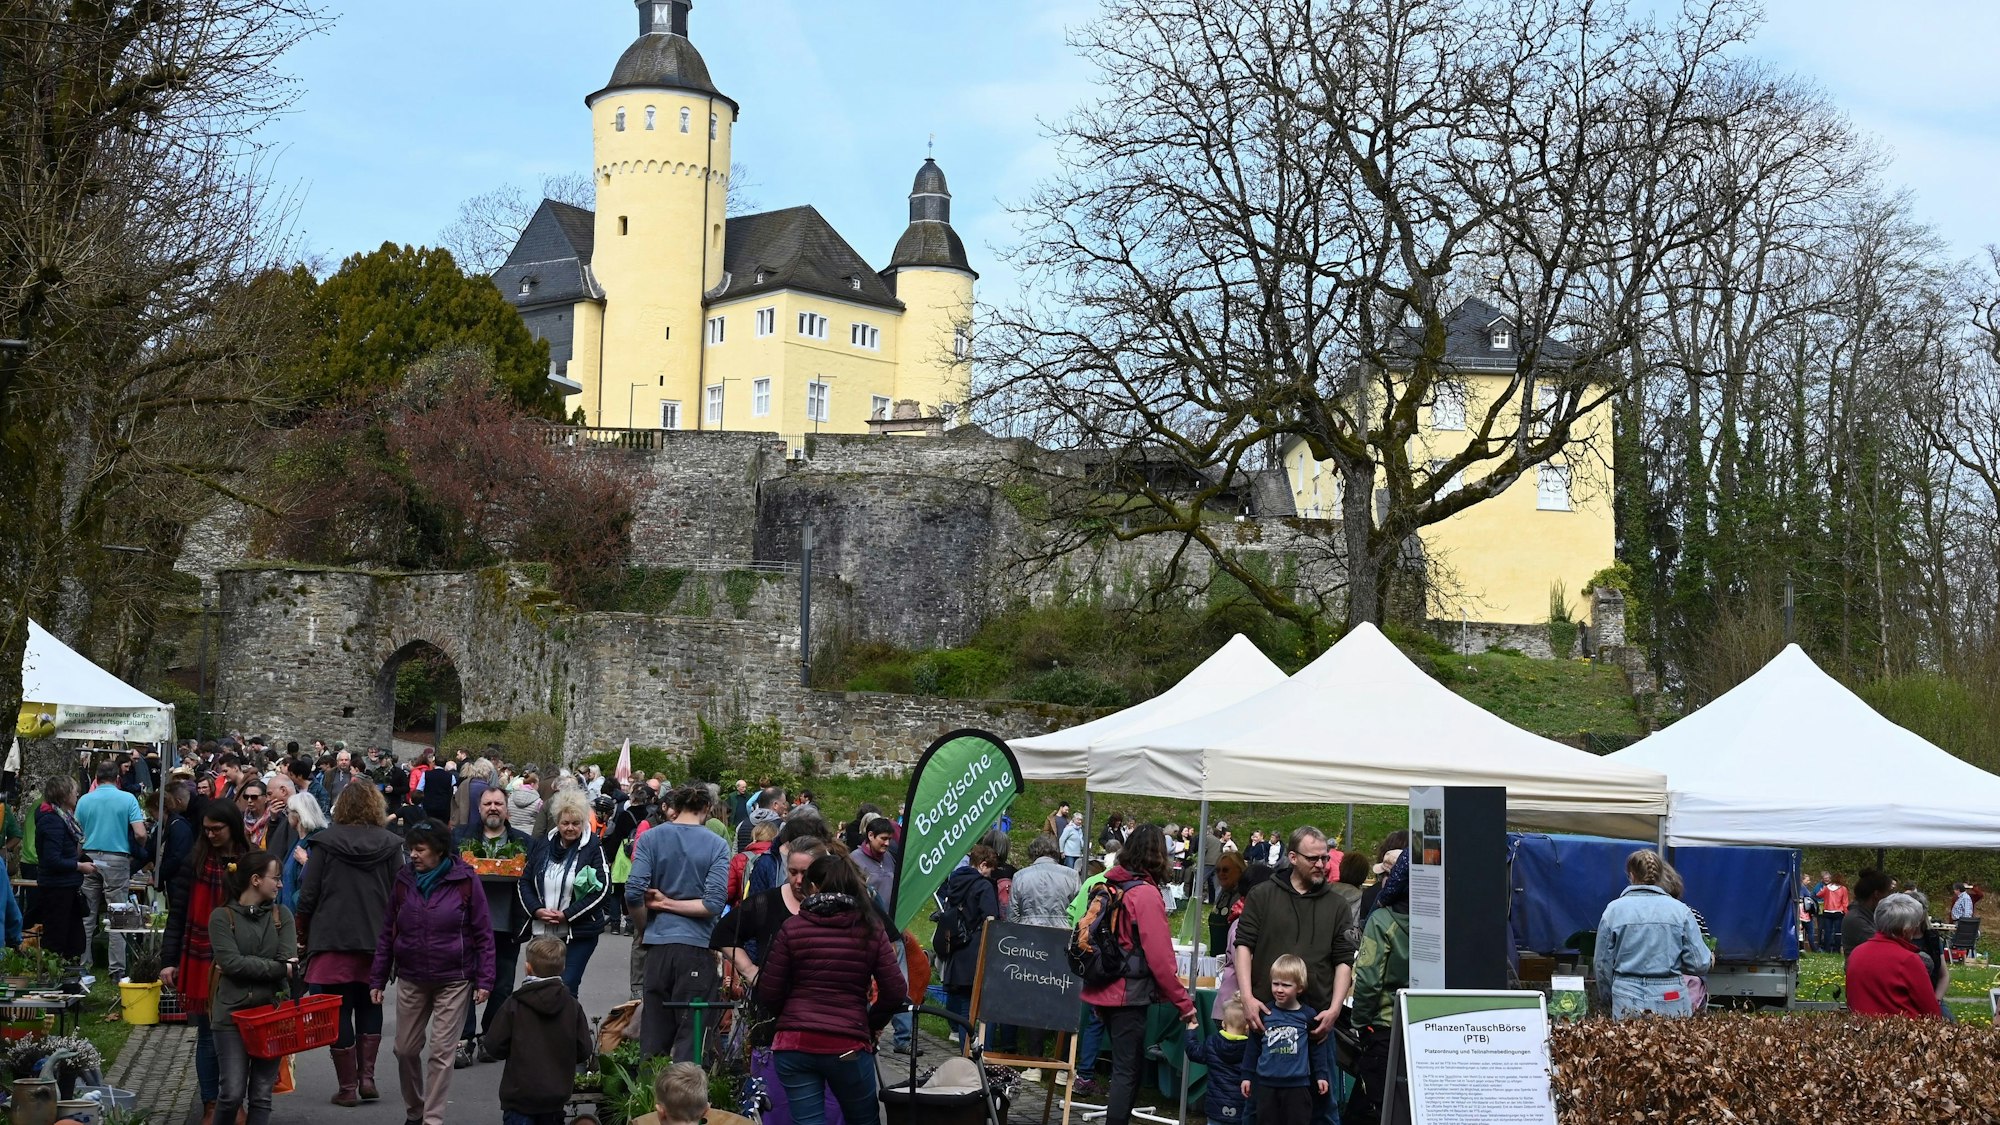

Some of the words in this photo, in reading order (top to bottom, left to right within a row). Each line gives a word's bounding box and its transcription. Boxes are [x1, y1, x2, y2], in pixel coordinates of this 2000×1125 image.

[132, 711, 156, 719] Garten-
[78, 718, 150, 727] Landschaftsgestaltung
[63, 728, 118, 736] www.naturgarten.org
[915, 753, 992, 836] Bergische
[918, 771, 1013, 875] Gartenarche
[1003, 964, 1074, 994] Patenschaft
[1424, 1023, 1527, 1033] PflanzenTauschBörse
[1463, 1034, 1490, 1044] (PTB)
[1424, 1048, 1459, 1056] Platzordnung
[1471, 1048, 1531, 1056] Teilnahmebedingungen
